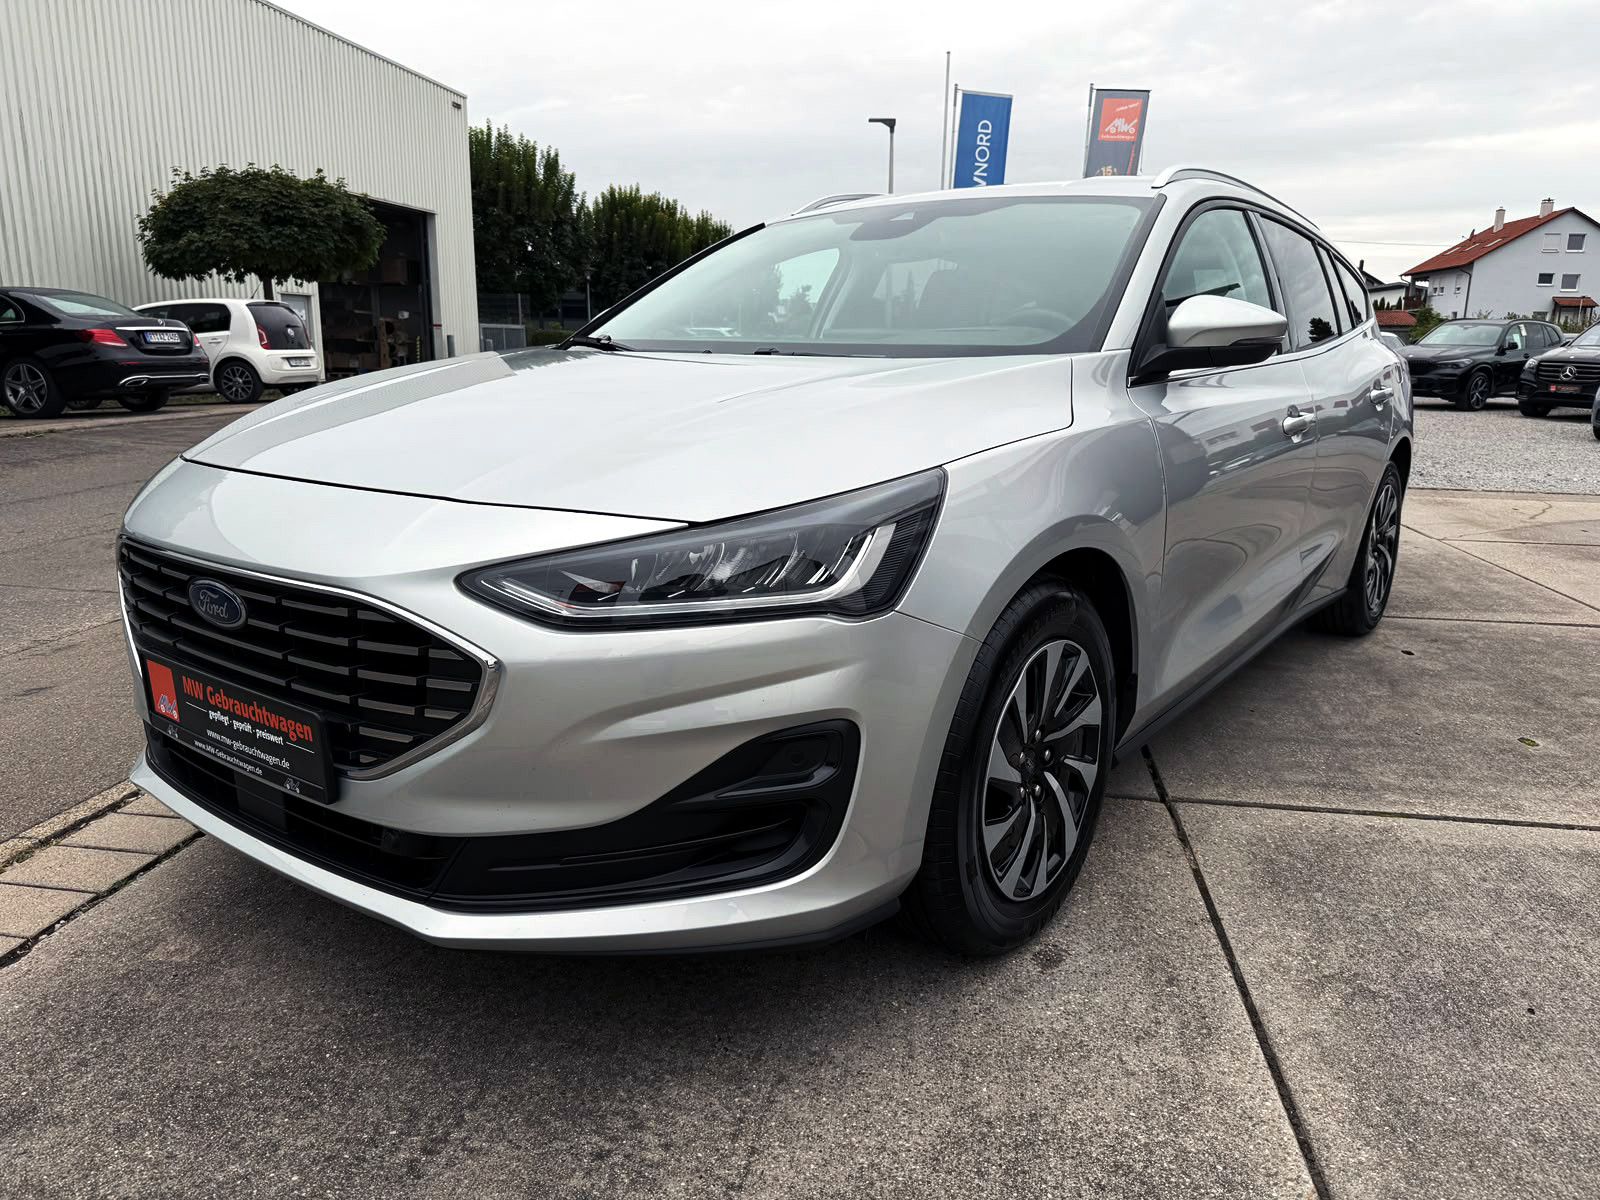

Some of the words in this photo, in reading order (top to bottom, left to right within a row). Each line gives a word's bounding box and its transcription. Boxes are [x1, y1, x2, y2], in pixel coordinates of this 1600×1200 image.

[200, 590, 229, 619] Ford
[182, 675, 203, 701] MW
[206, 685, 313, 742] Gebrauchtwagen
[208, 710, 229, 726] gepflegt
[233, 719, 252, 734] geprüft
[256, 729, 284, 745] preiswert
[194, 740, 263, 776] www.MW-Gebrauchtwagen.de
[206, 729, 290, 769] www.mw-gebrauchtwagen.de
